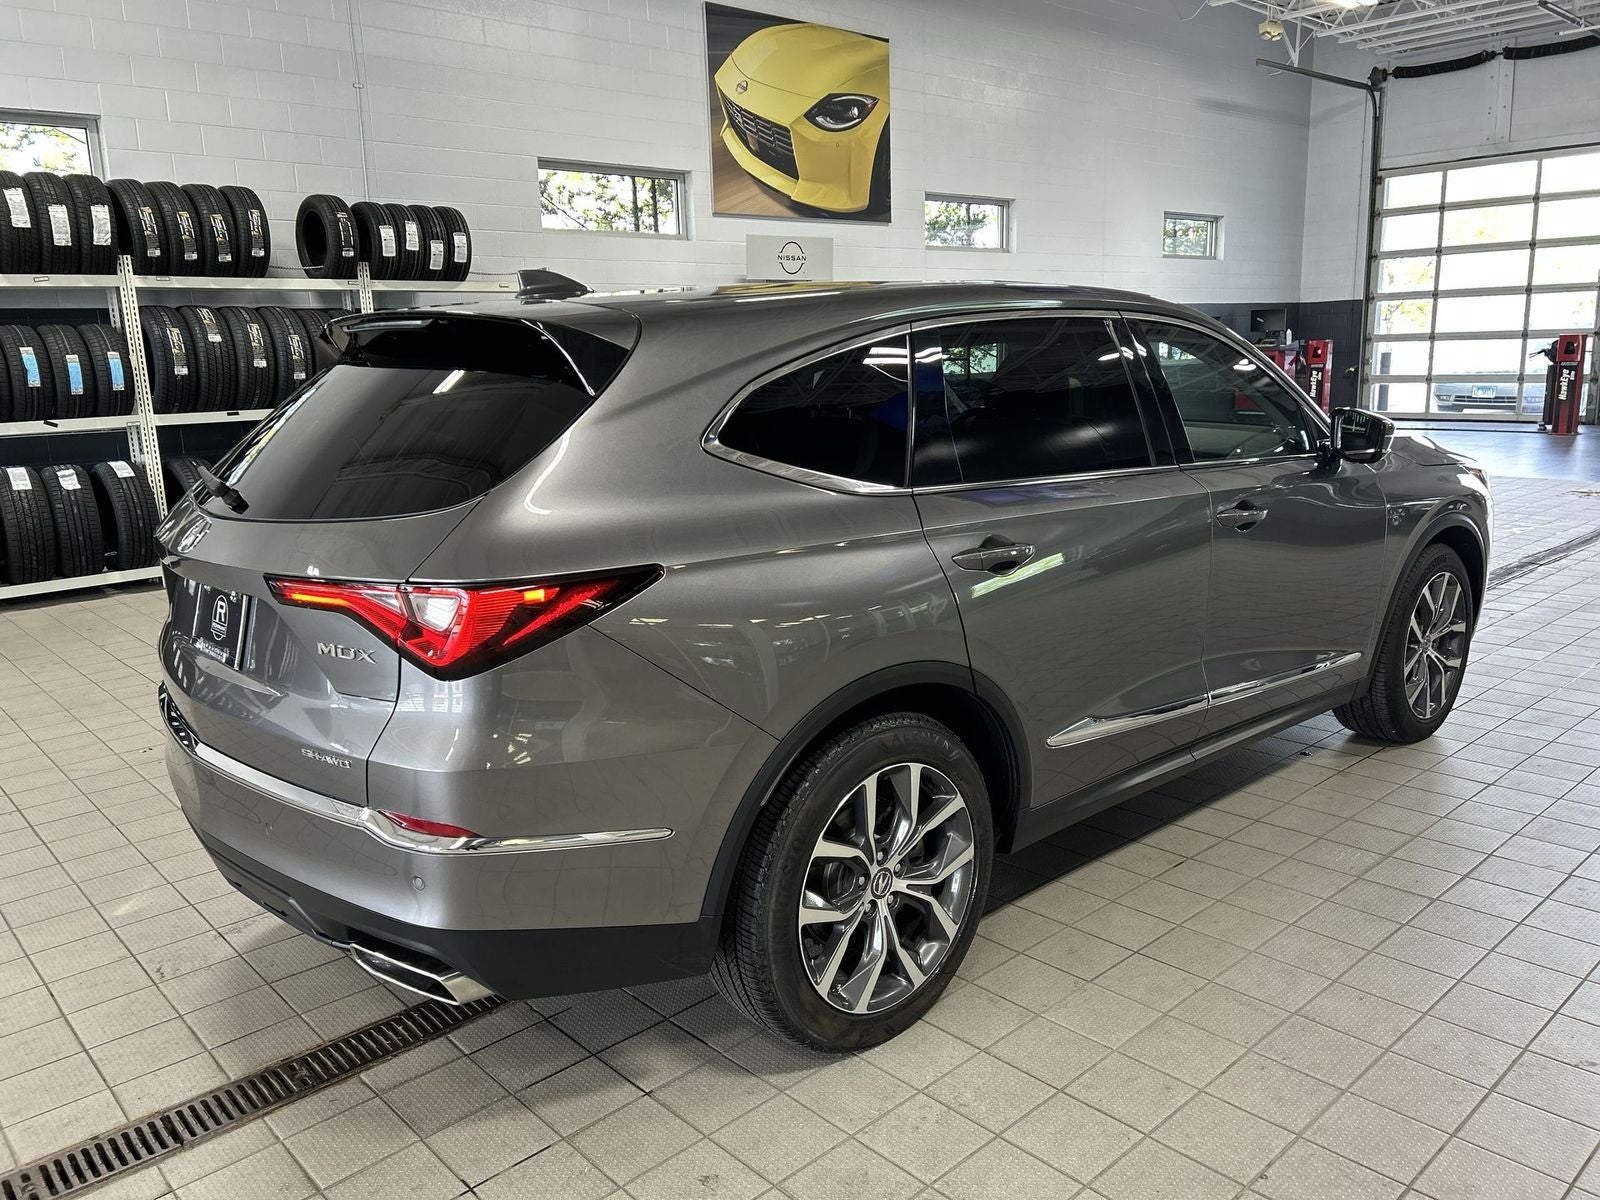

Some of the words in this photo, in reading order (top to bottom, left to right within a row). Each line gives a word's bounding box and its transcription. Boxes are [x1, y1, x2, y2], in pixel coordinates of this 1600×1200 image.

[777, 254, 807, 262] NISSAN
[1309, 370, 1319, 398] HawkEye
[1558, 368, 1571, 401] HawkEye
[215, 600, 226, 623] R
[316, 641, 377, 665] MDX
